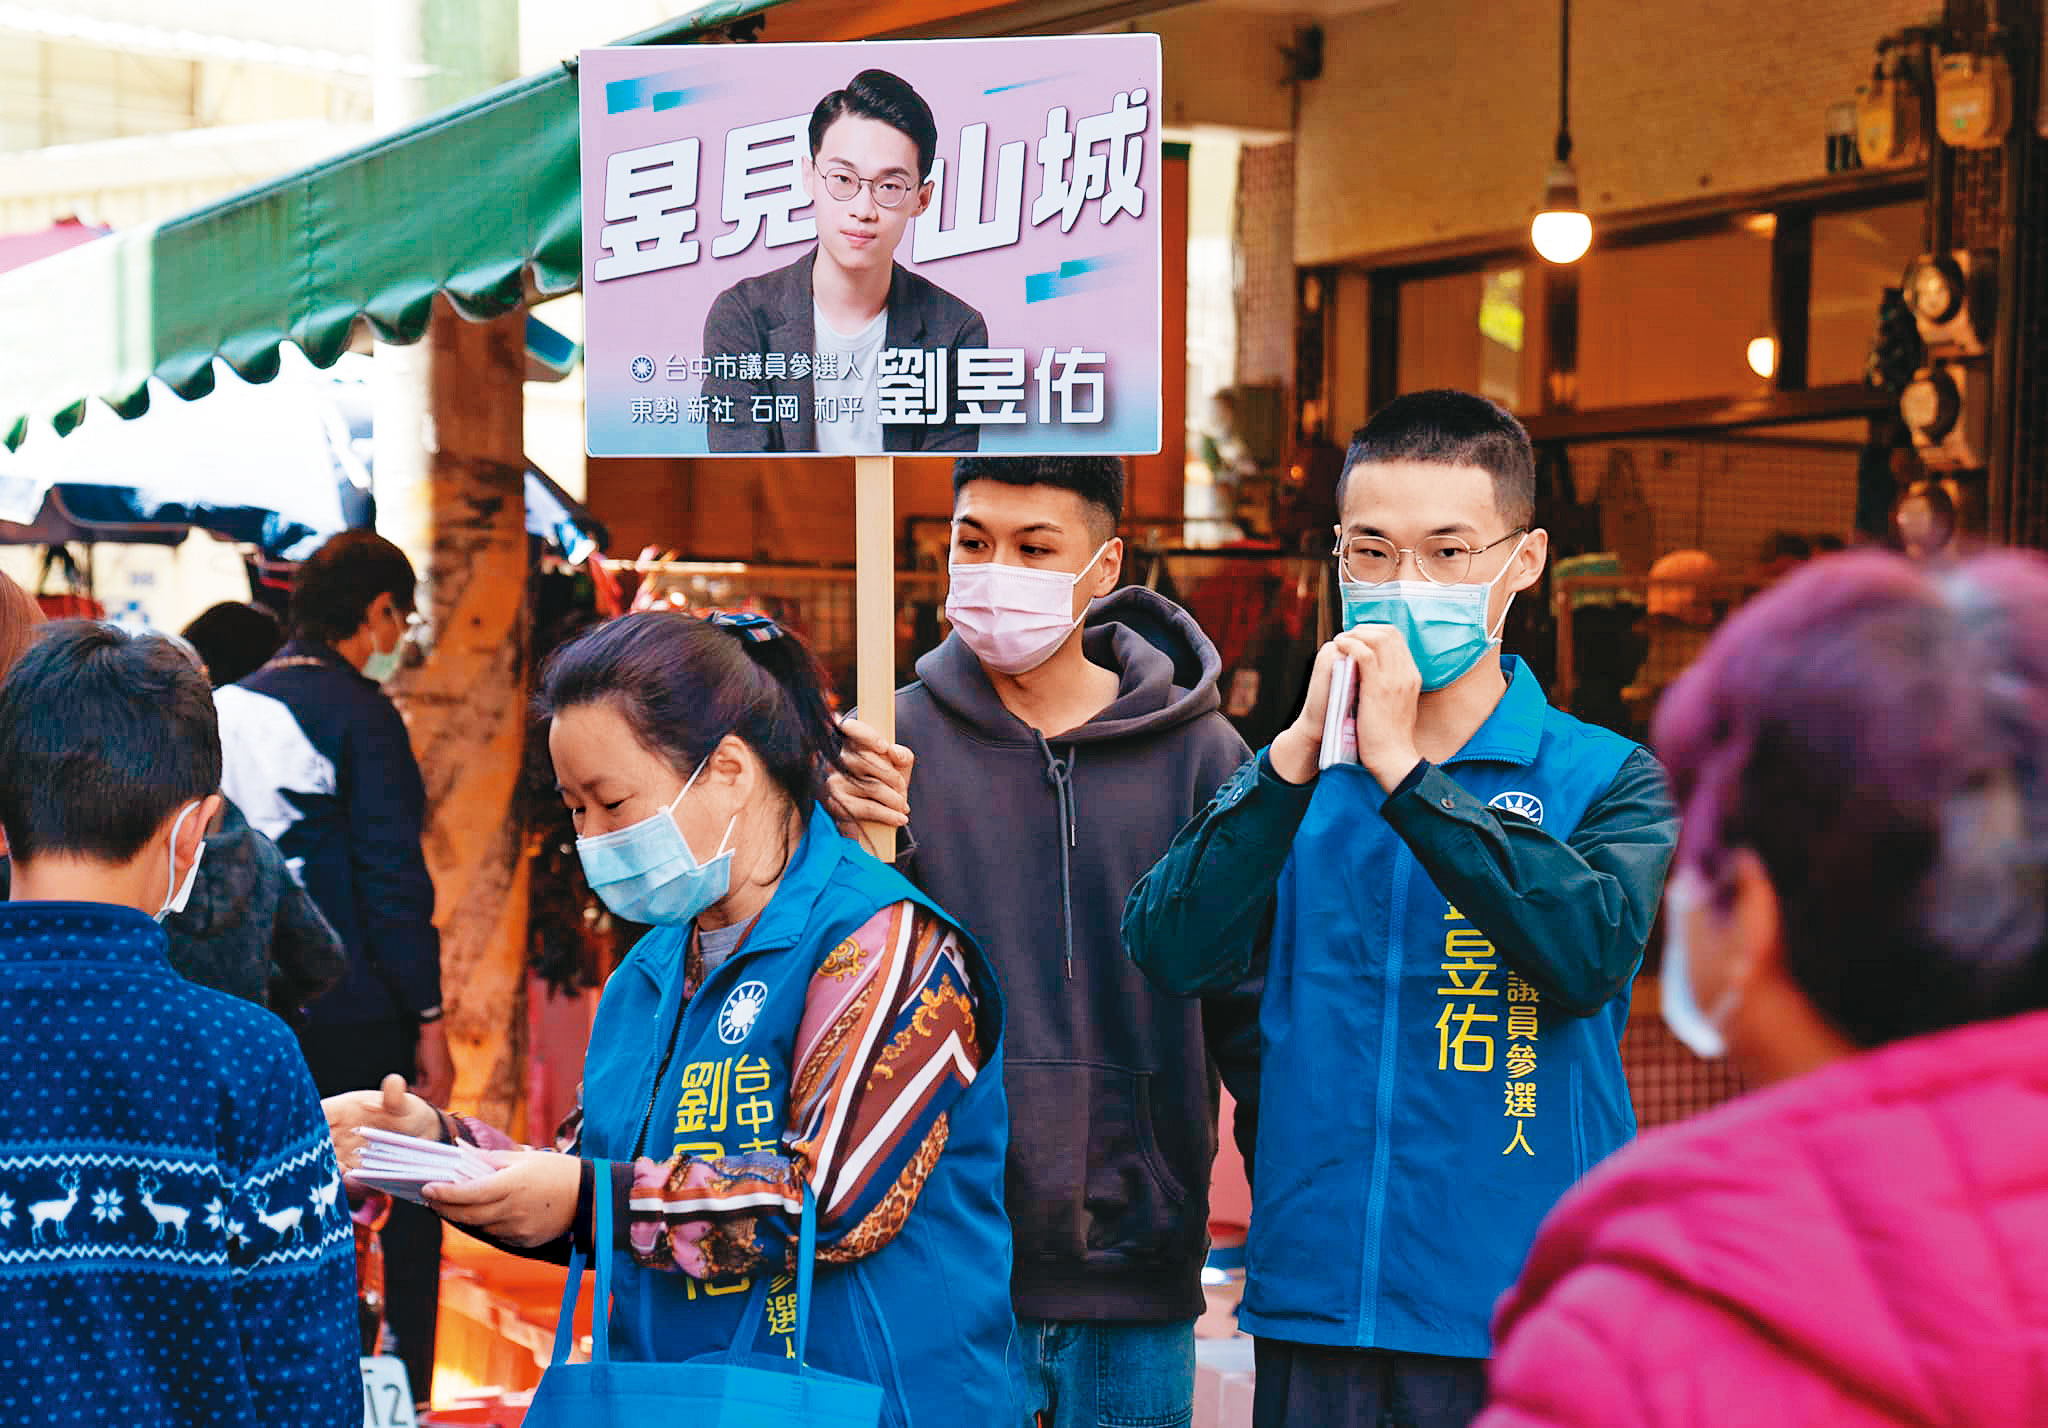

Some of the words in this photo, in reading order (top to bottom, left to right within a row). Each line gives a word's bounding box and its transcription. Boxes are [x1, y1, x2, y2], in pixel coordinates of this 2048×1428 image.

[665, 352, 863, 380] 台中市議員參選人
[877, 346, 1106, 424] 劉昱佑
[630, 396, 679, 423] 東勢
[687, 396, 736, 423] 新社
[750, 396, 799, 422] 石岡
[814, 396, 863, 423] 和平
[1435, 901, 1498, 1071] 昱佑
